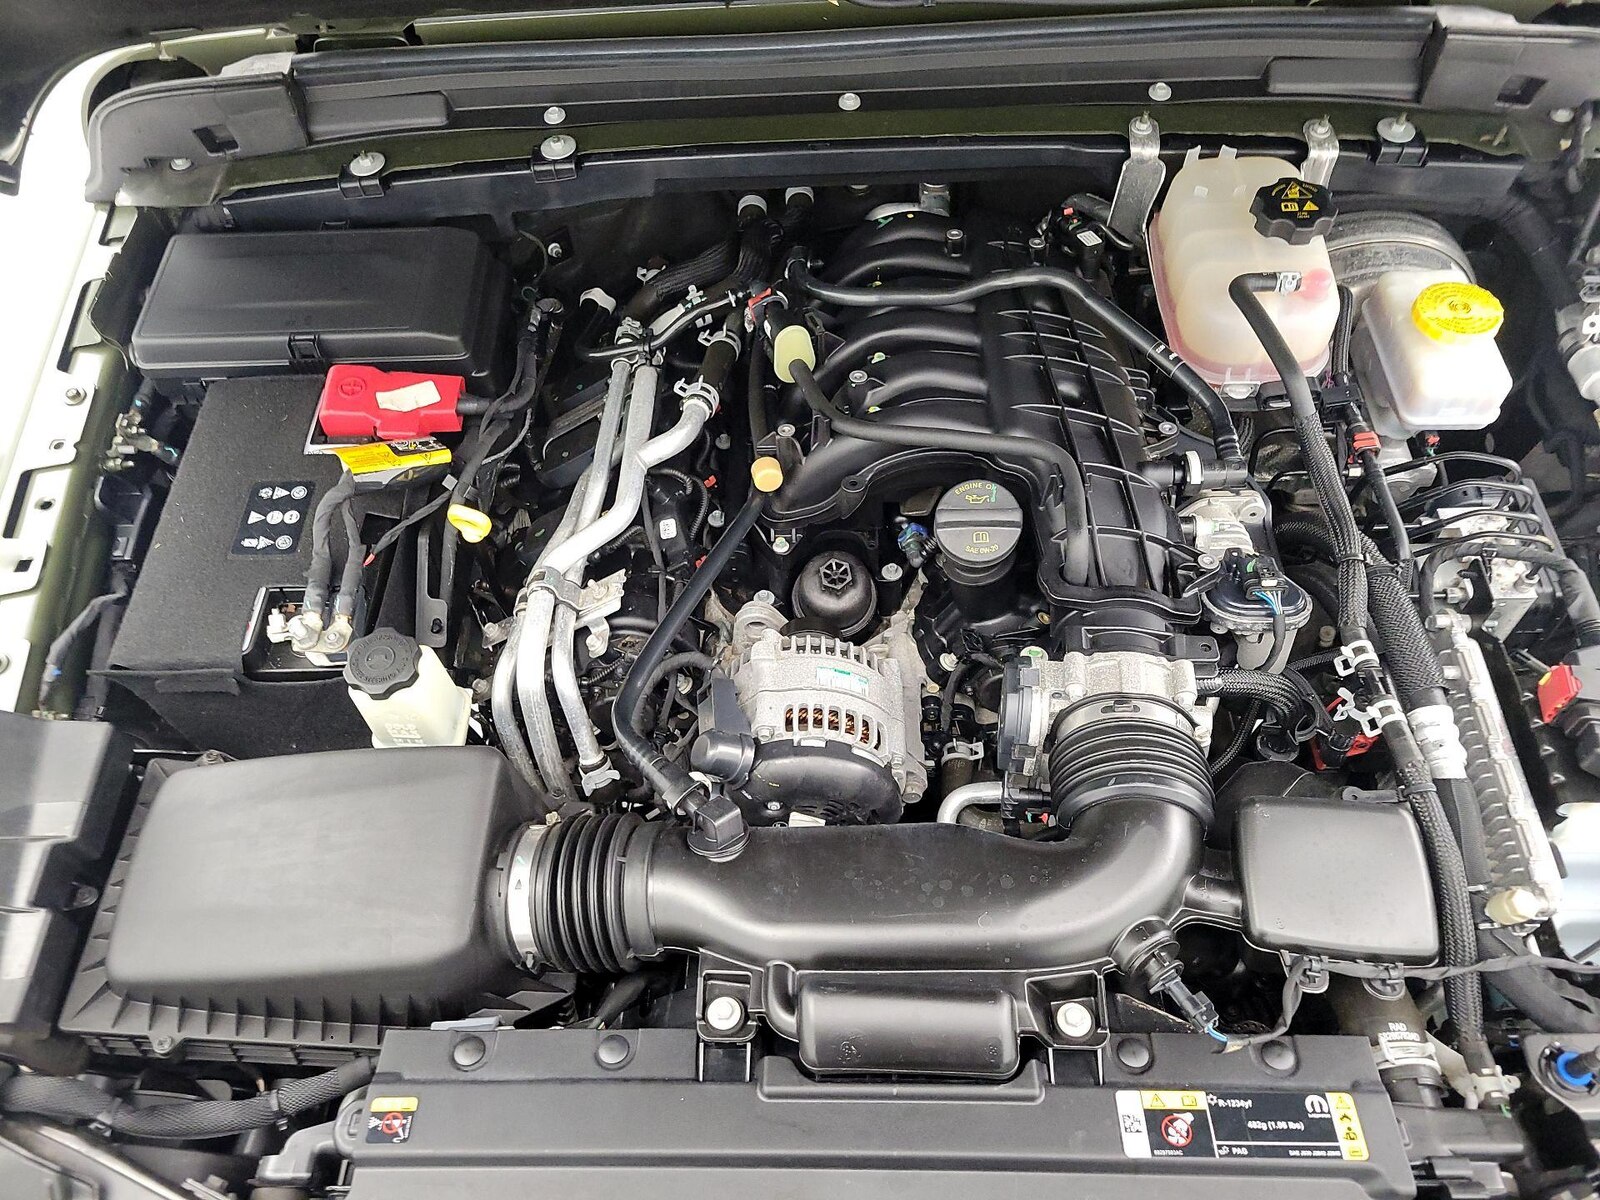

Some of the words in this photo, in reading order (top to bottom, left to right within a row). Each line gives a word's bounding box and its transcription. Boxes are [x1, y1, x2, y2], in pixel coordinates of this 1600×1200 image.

[954, 482, 983, 495] ENGINE
[965, 545, 980, 554] SAE
[1388, 1022, 1407, 1032] RAD
[1217, 1098, 1253, 1110] R-1234yf
